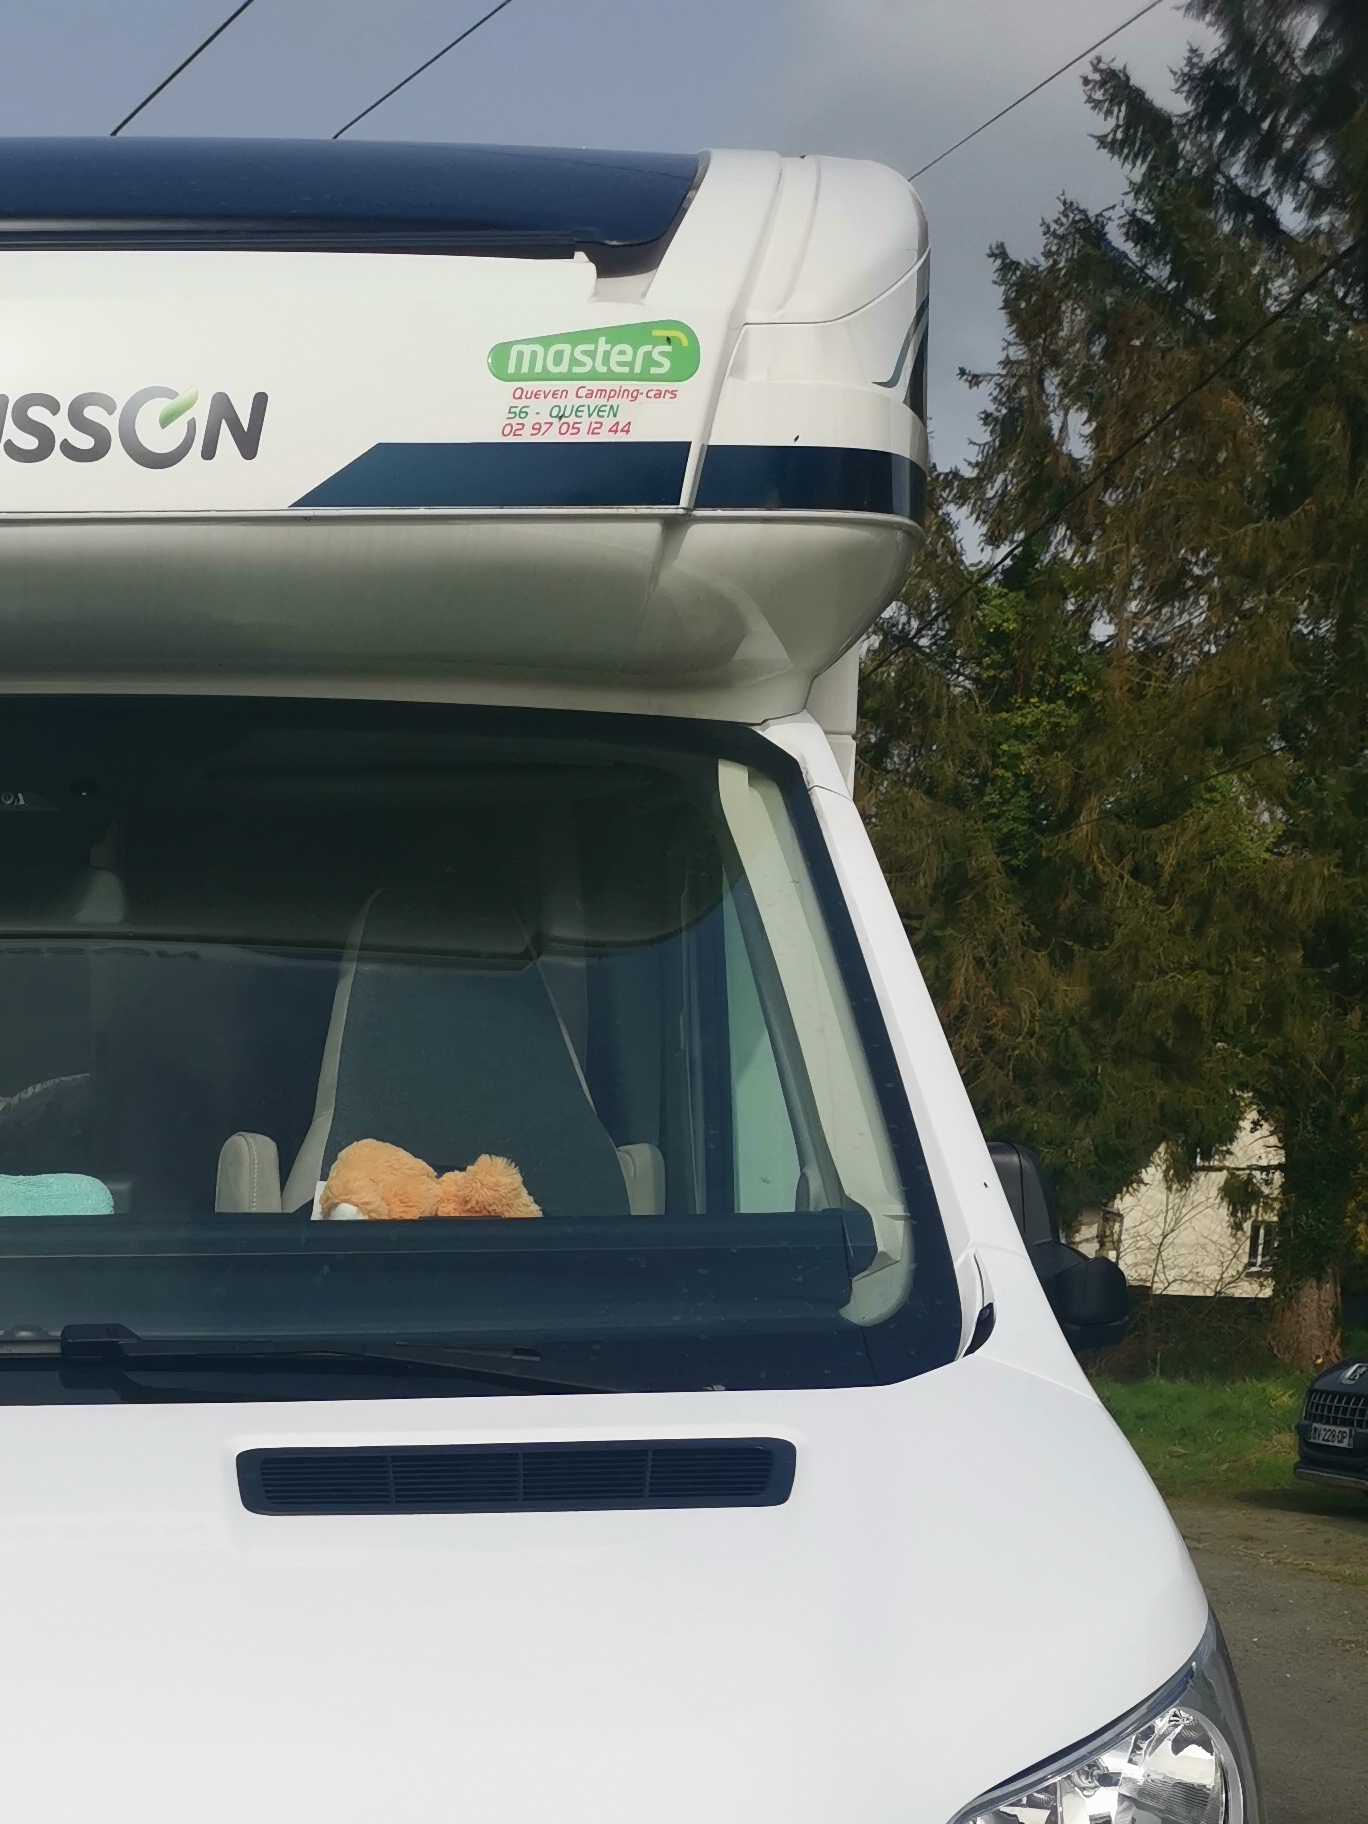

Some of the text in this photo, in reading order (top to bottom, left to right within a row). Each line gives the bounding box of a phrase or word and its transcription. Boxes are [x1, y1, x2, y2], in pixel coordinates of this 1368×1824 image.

[507, 336, 673, 374] masters
[512, 385, 678, 402] Queven Camping-cars
[505, 405, 530, 420] 56
[548, 404, 620, 419] QUEVEN
[501, 421, 632, 437] 02 97 05 12 44
